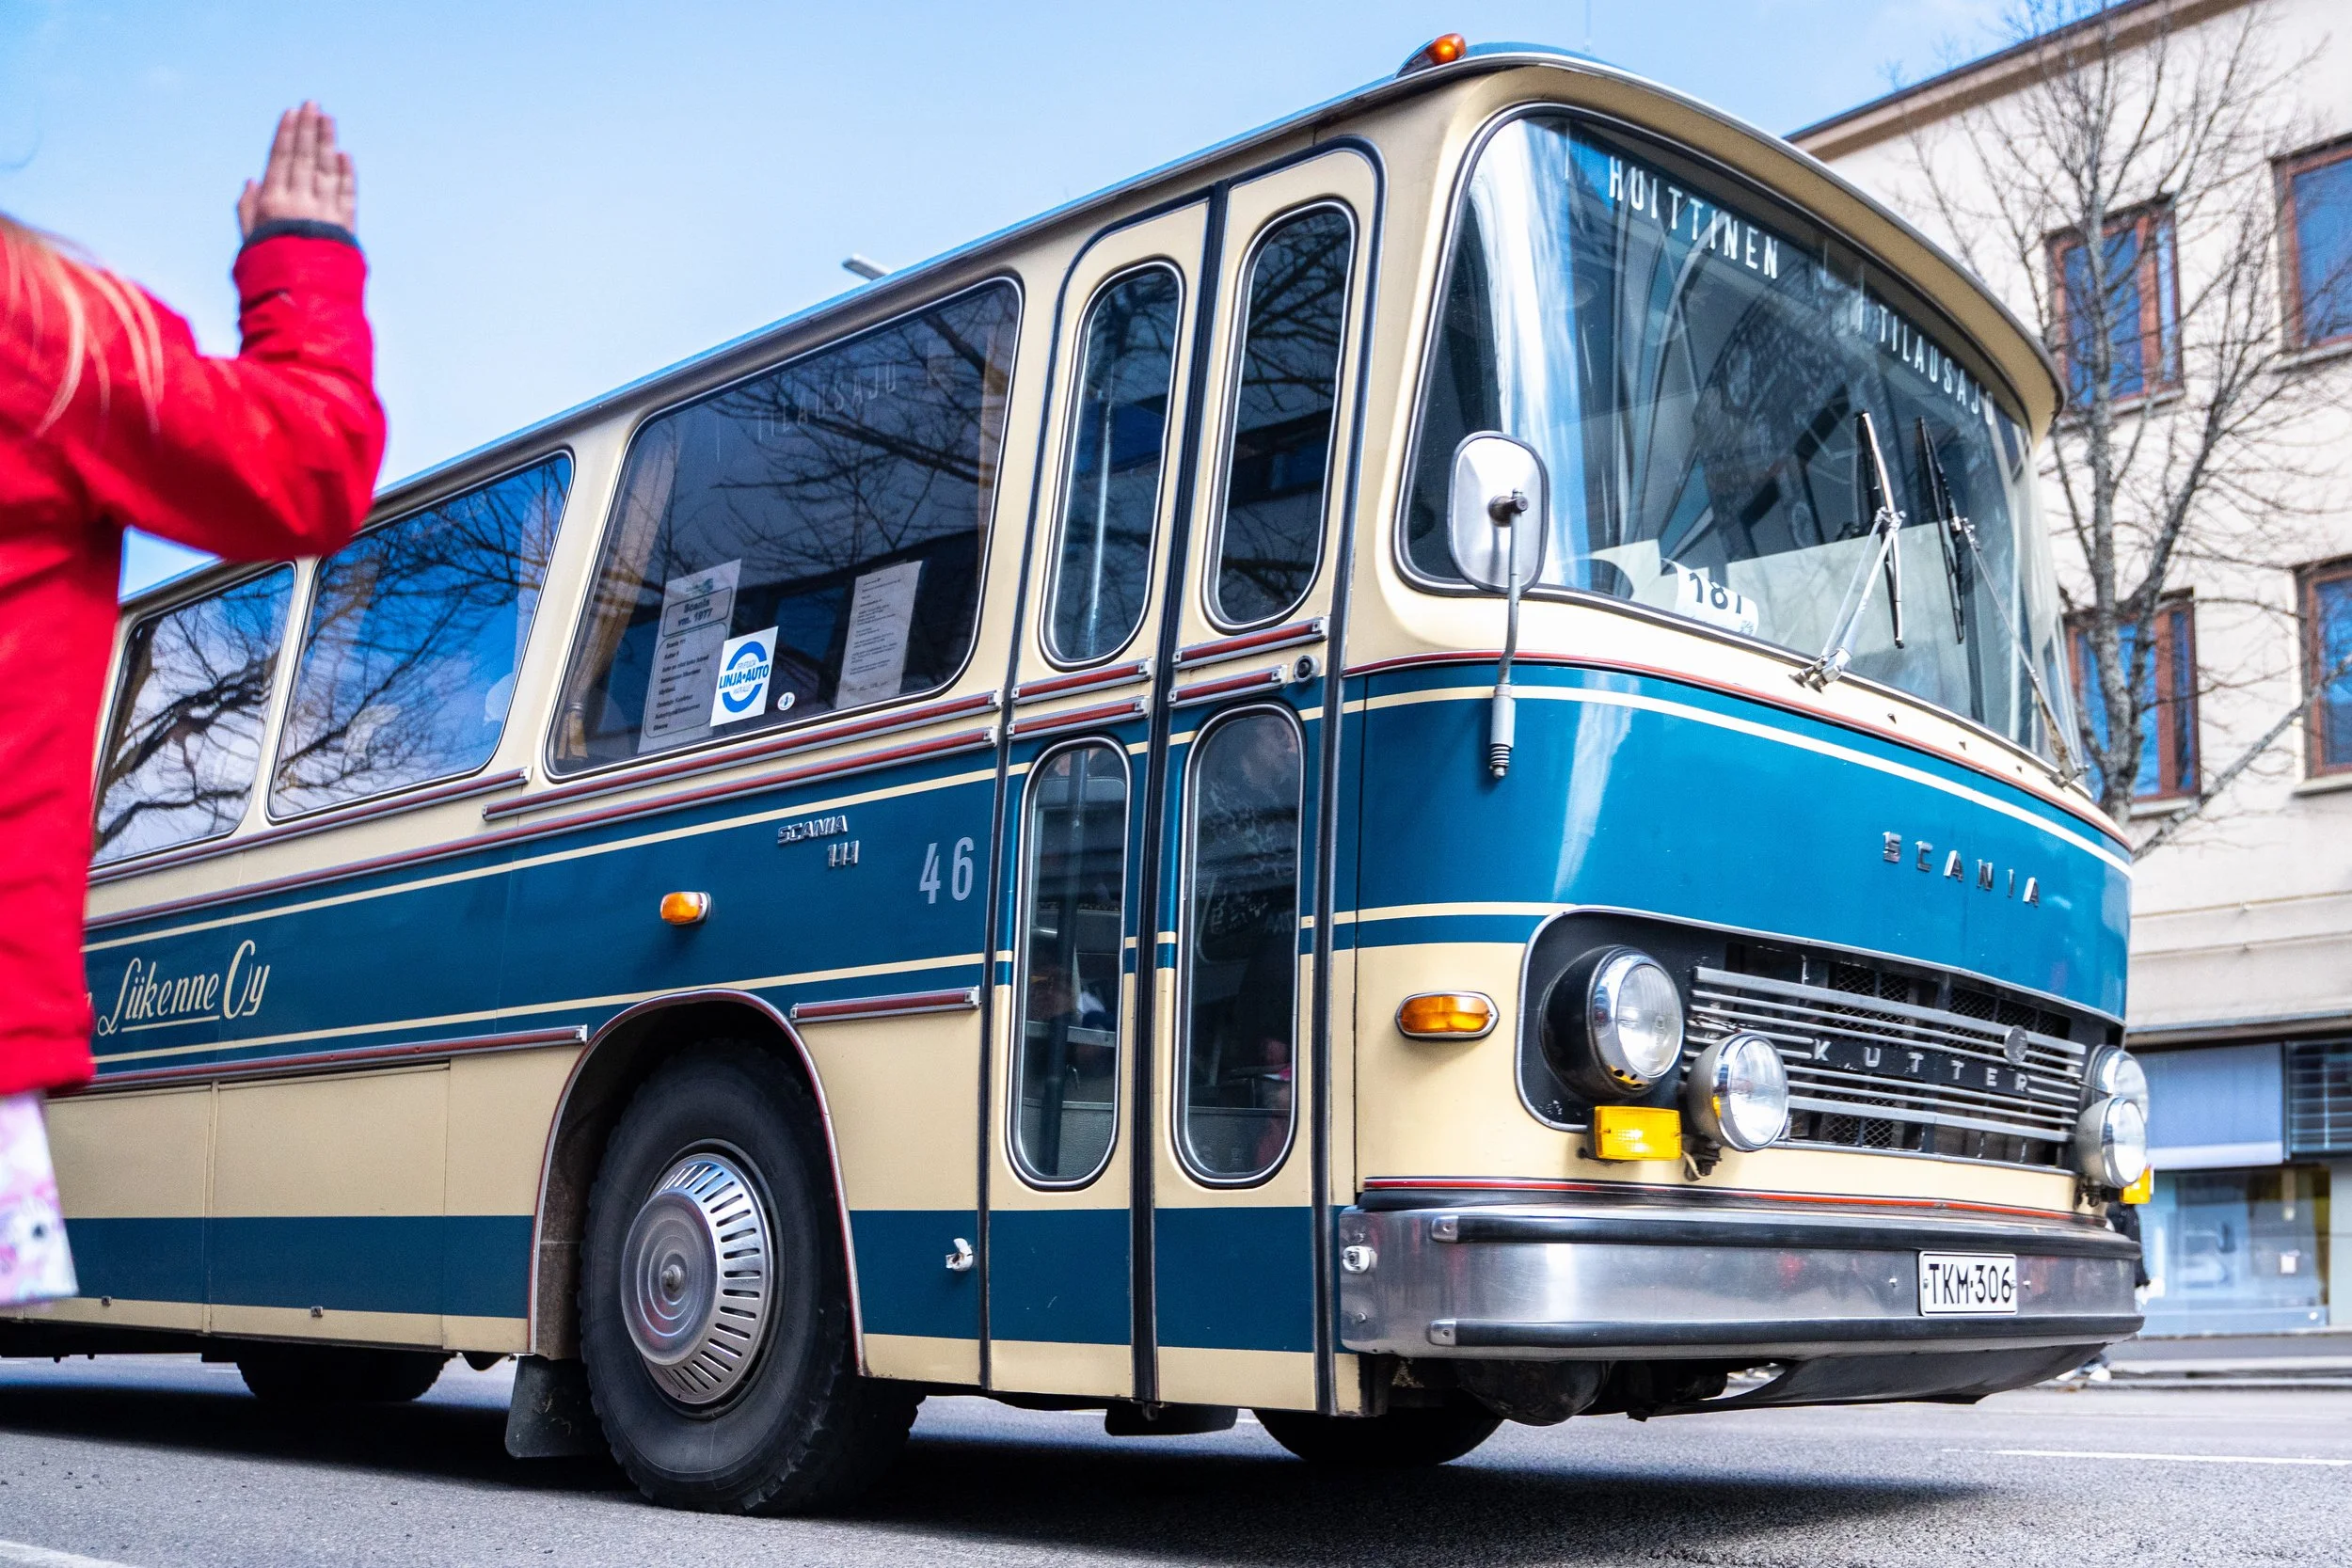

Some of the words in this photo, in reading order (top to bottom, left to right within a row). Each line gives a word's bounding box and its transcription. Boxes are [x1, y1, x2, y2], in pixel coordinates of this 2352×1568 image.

[1609, 155, 1778, 279] HUITTINEN
[1879, 304, 1994, 426] TILAUSAJO
[777, 815, 848, 844] SCANIA
[827, 840, 860, 867] 111
[919, 836, 975, 905] 46
[1883, 831, 2041, 908] SCANIA
[97, 958, 220, 1037] Liikenne
[223, 940, 271, 1020] Oy
[1812, 1037, 2029, 1093] KUTTER
[1929, 1263, 2011, 1305] TKM-306
